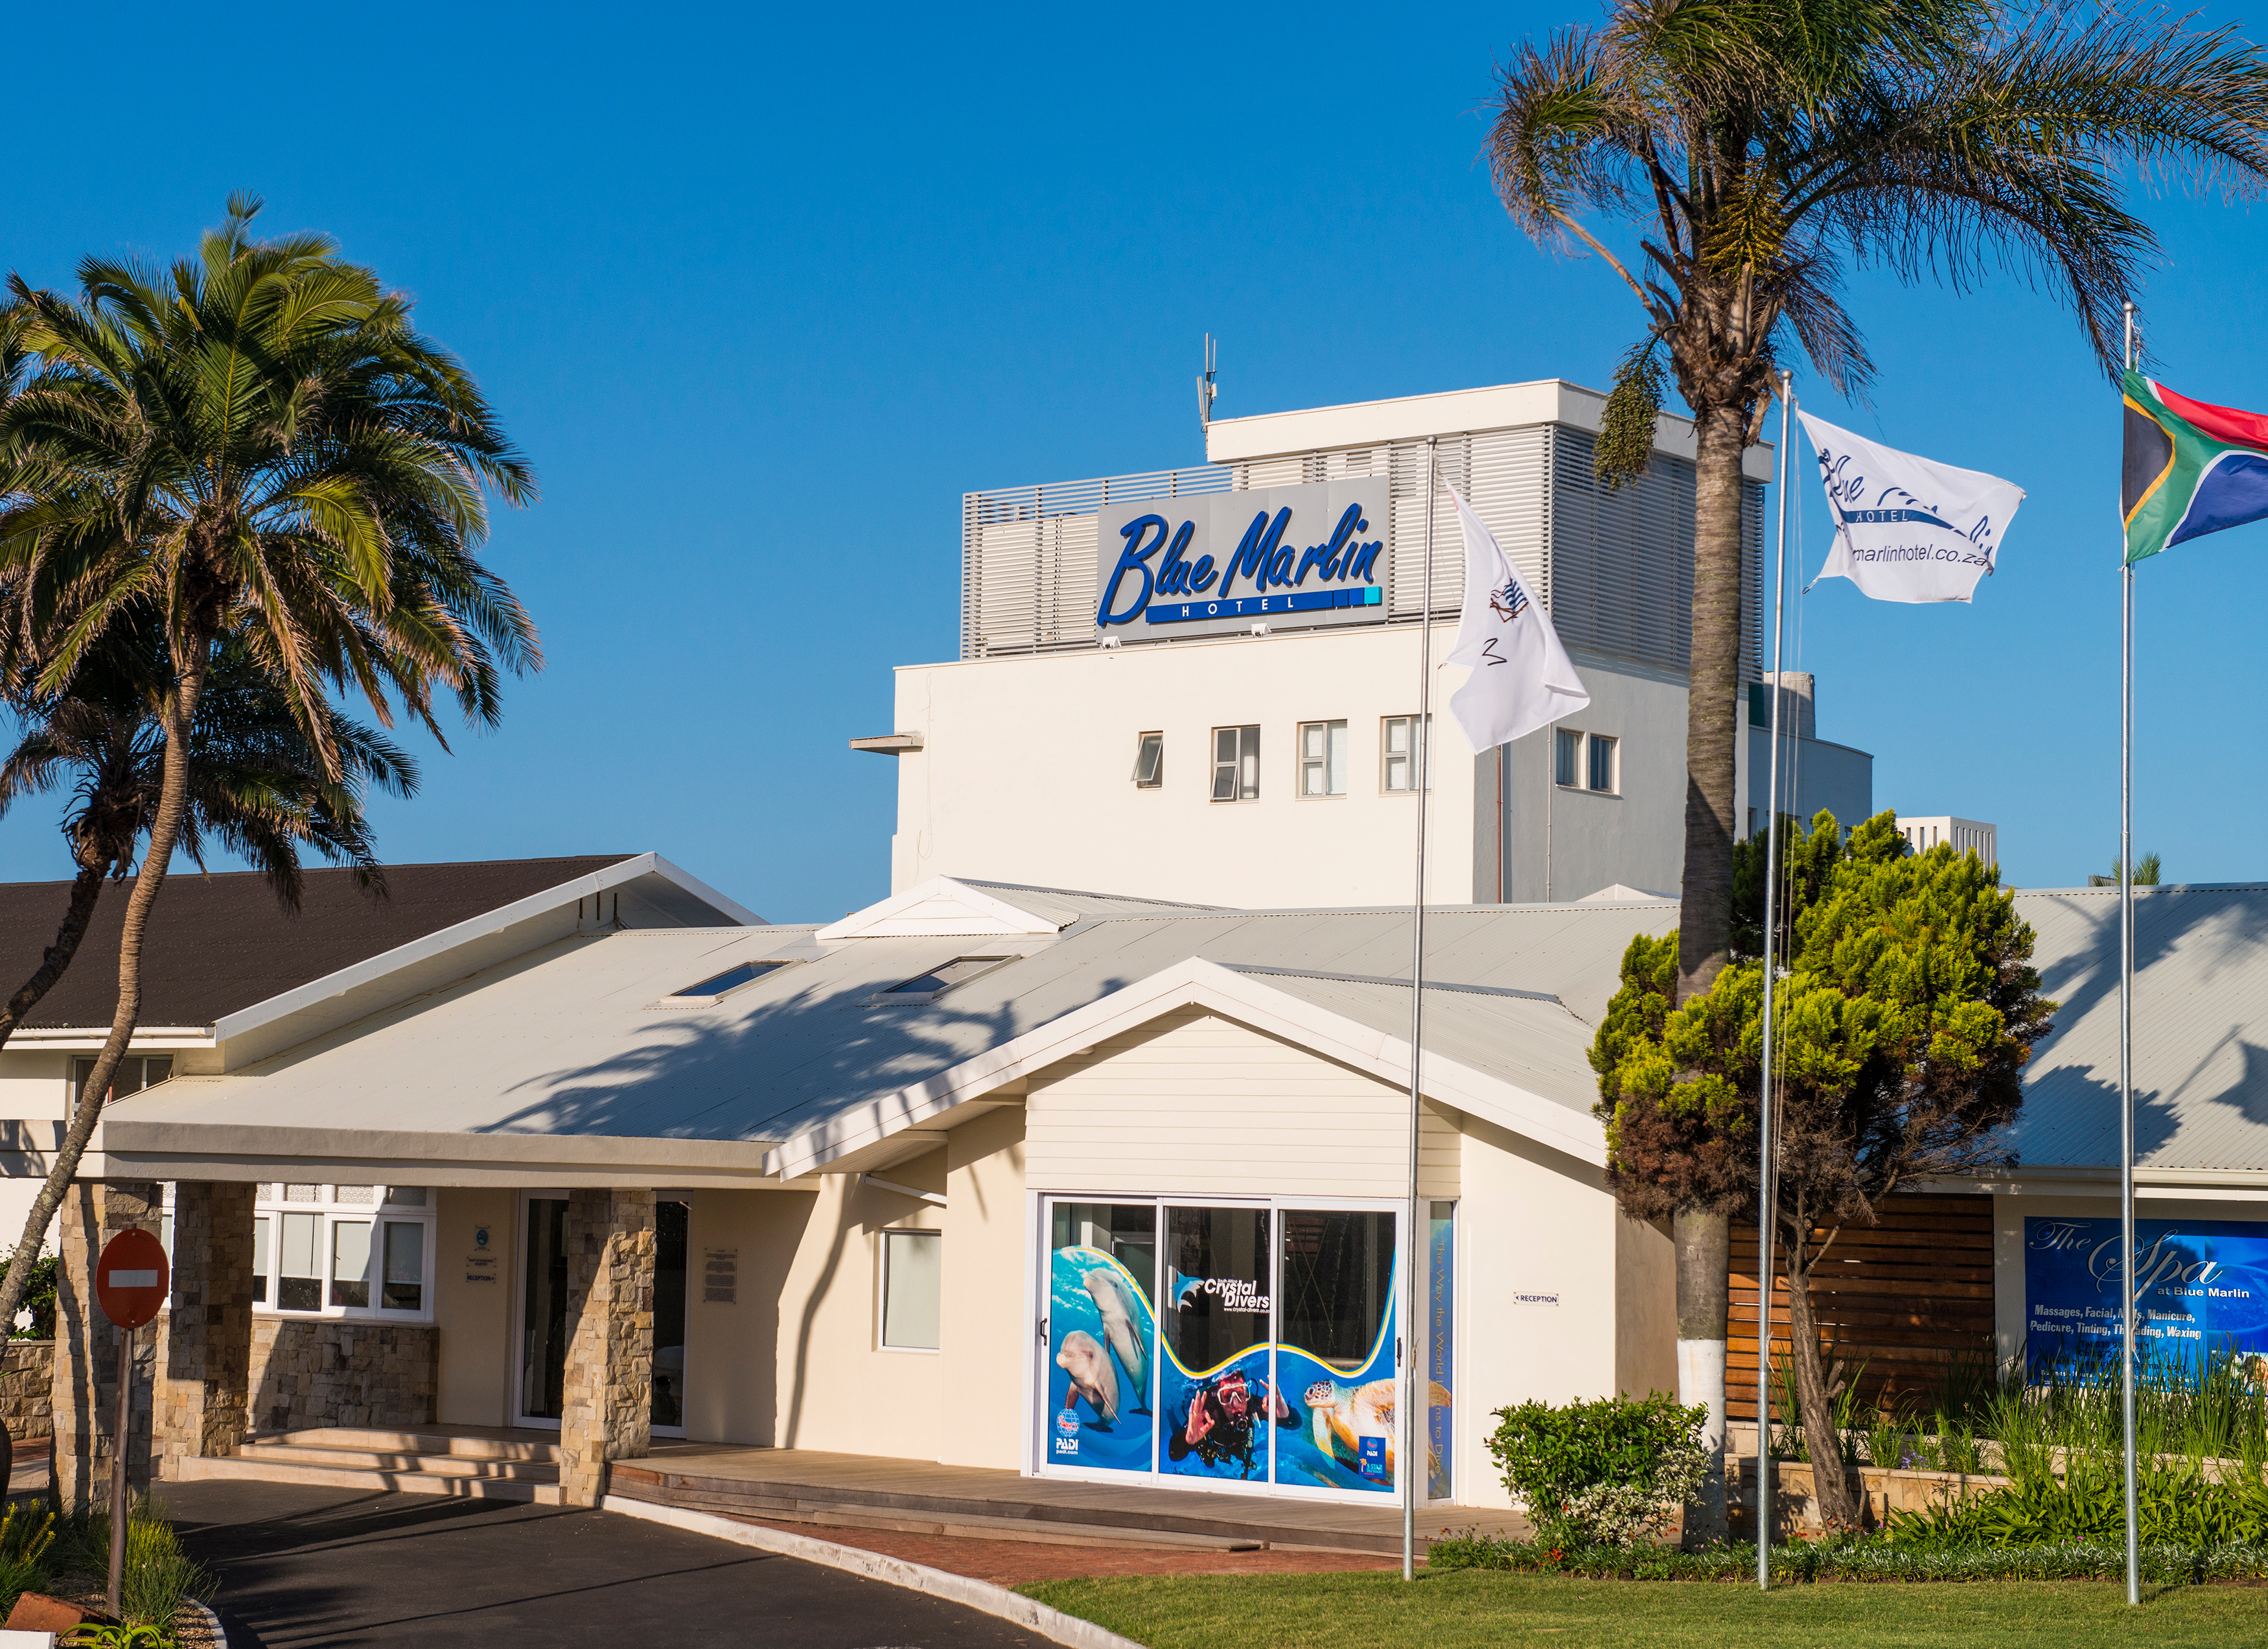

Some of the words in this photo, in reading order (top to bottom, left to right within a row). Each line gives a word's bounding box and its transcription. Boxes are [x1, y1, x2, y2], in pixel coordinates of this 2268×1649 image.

[1855, 510, 1908, 522] HOTEL
[1097, 514, 1220, 628] Blue
[1218, 503, 1383, 599] Marlin
[1182, 596, 1294, 617] HOTEL
[1437, 1240, 1445, 1264] The
[2030, 1220, 2092, 1250] The
[2087, 1228, 2223, 1302] Spa
[1204, 1278, 1257, 1298] Crystal
[1434, 1269, 1444, 1303] Way
[2157, 1287, 2170, 1295] at
[2173, 1287, 2204, 1297] Blue
[2208, 1287, 2250, 1298] Marlin
[1223, 1290, 1270, 1309] Divers
[1520, 1295, 1557, 1303] RECEPTION
[1436, 1308, 1444, 1327] the
[2035, 1304, 2083, 1319] Massages,
[2085, 1306, 2116, 1320] Facial,
[2118, 1308, 2146, 1322] Nls,
[2147, 1309, 2195, 1323] Manicure,
[2030, 1320, 2074, 1334] Pedicure,
[2076, 1322, 2111, 1336] Tinting,
[2113, 1324, 2164, 1339] Thading,
[2166, 1326, 2201, 1340] Waxing
[1435, 1426, 1442, 1439] to
[1056, 1437, 1078, 1451] PADI
